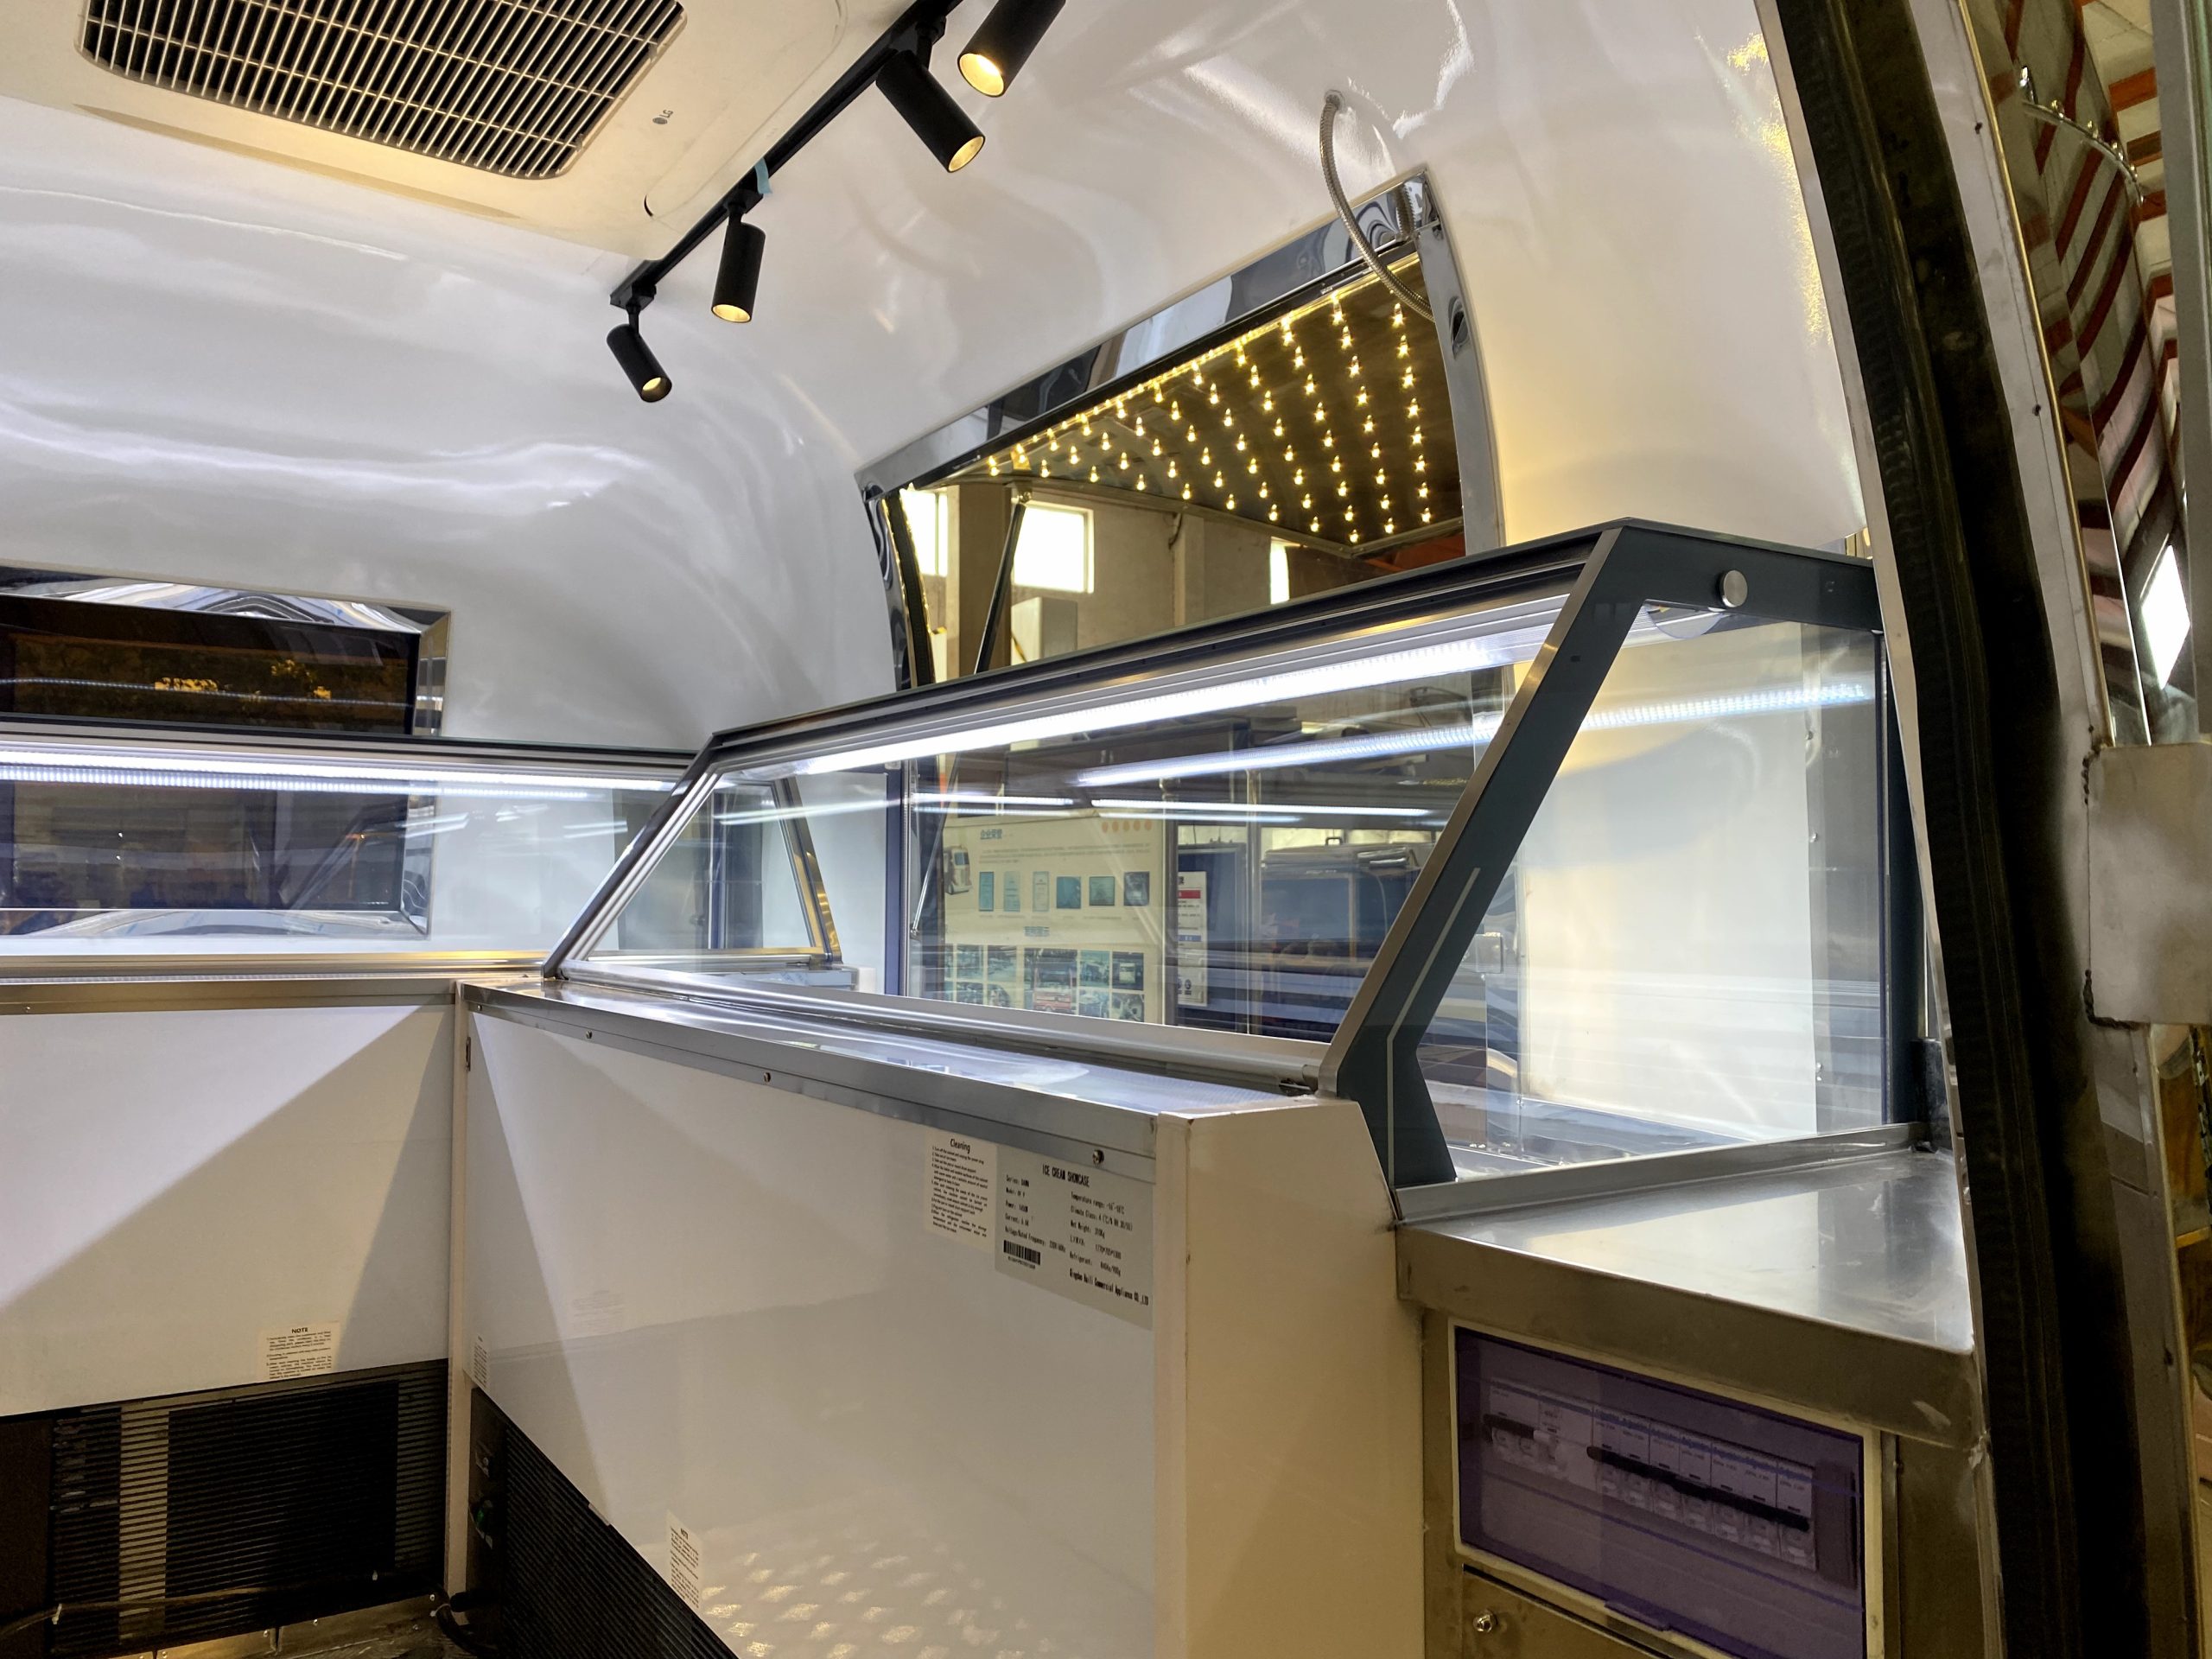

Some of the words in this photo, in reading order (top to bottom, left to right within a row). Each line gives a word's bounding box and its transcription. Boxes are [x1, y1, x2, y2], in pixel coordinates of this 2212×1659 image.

[950, 1138, 970, 1154] Cleaning
[1052, 1166, 1065, 1180] CREAM
[1067, 1171, 1090, 1188] SHOWCASE
[1094, 1276, 1114, 1293] Commercial
